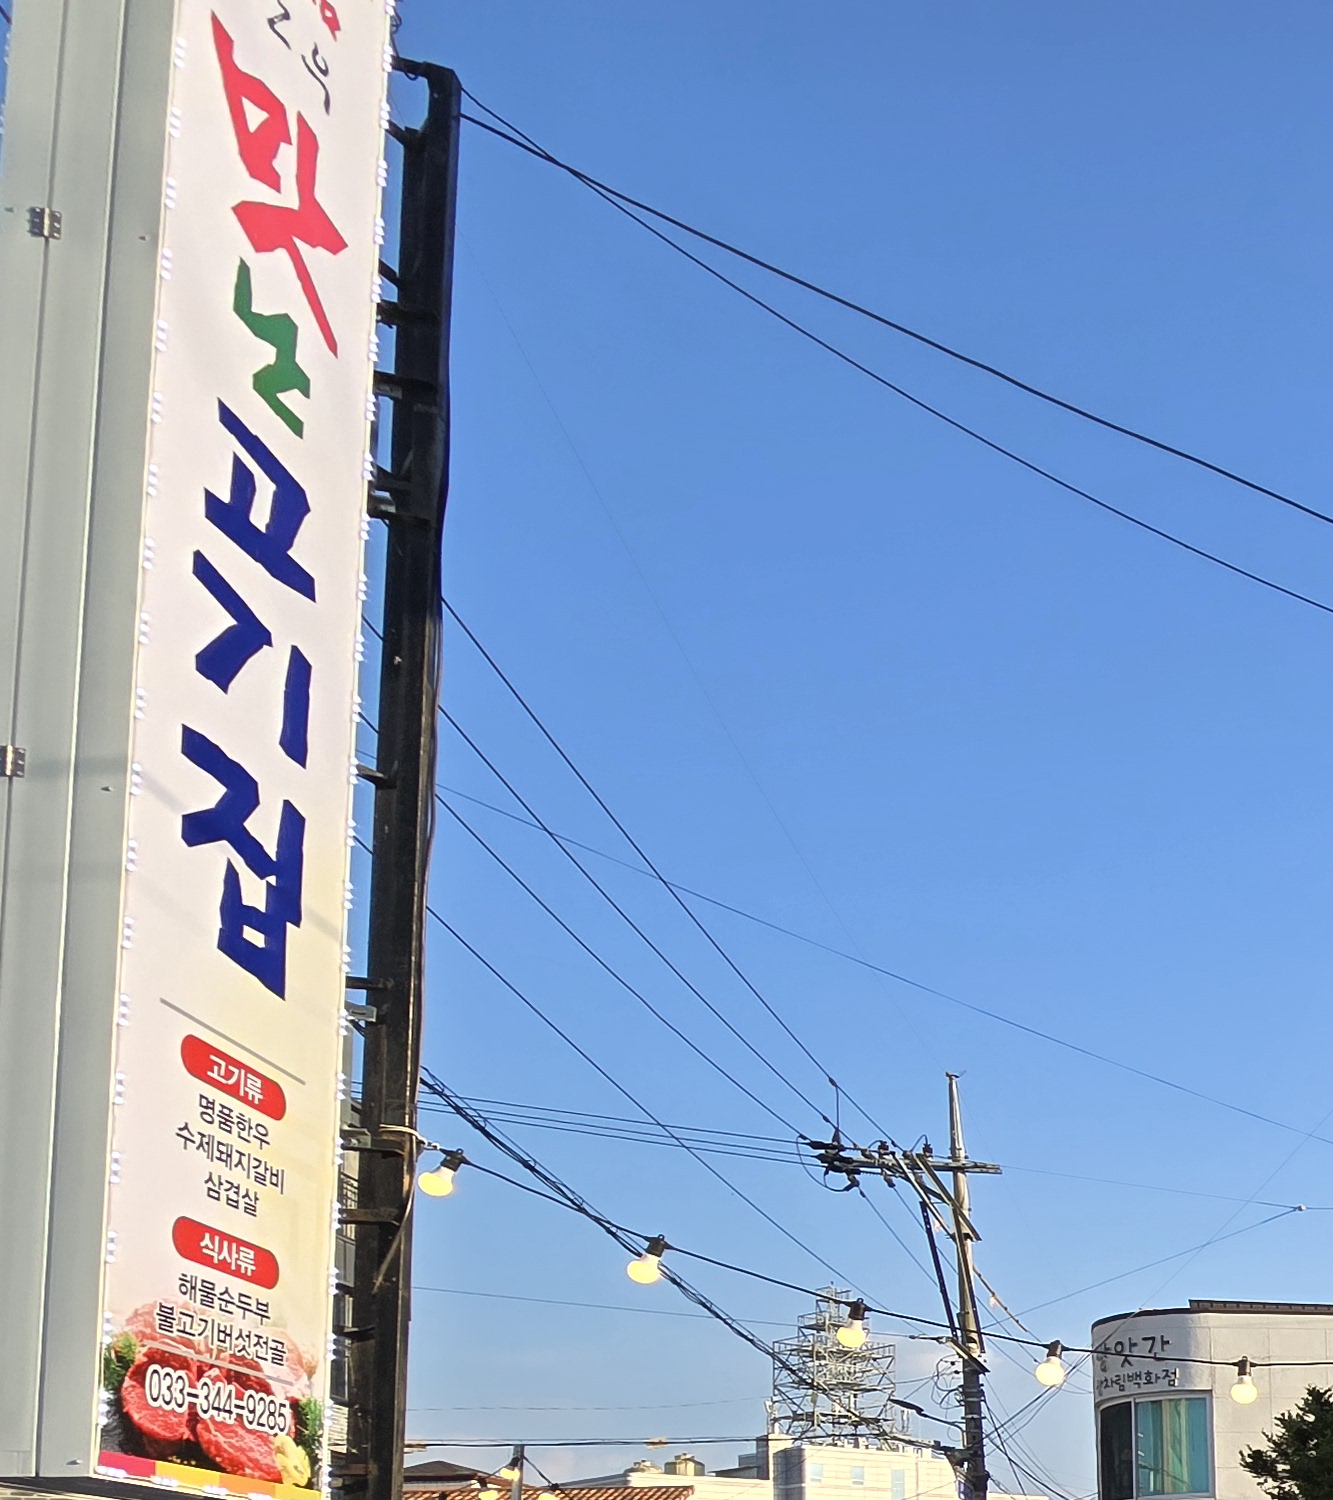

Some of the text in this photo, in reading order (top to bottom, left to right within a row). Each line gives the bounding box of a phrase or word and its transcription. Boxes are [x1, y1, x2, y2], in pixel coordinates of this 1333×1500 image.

[206, 1055, 264, 1105] 고기류
[198, 1094, 272, 1149] 명품한우
[174, 1120, 286, 1196] 수제돼지갈비
[203, 1170, 260, 1218] 삼겹살
[198, 1230, 258, 1278] 식사류
[177, 1272, 271, 1327] 해물순두부
[154, 1300, 288, 1367] 불고기버섯전골
[146, 1365, 289, 1434] 033-344-9285
